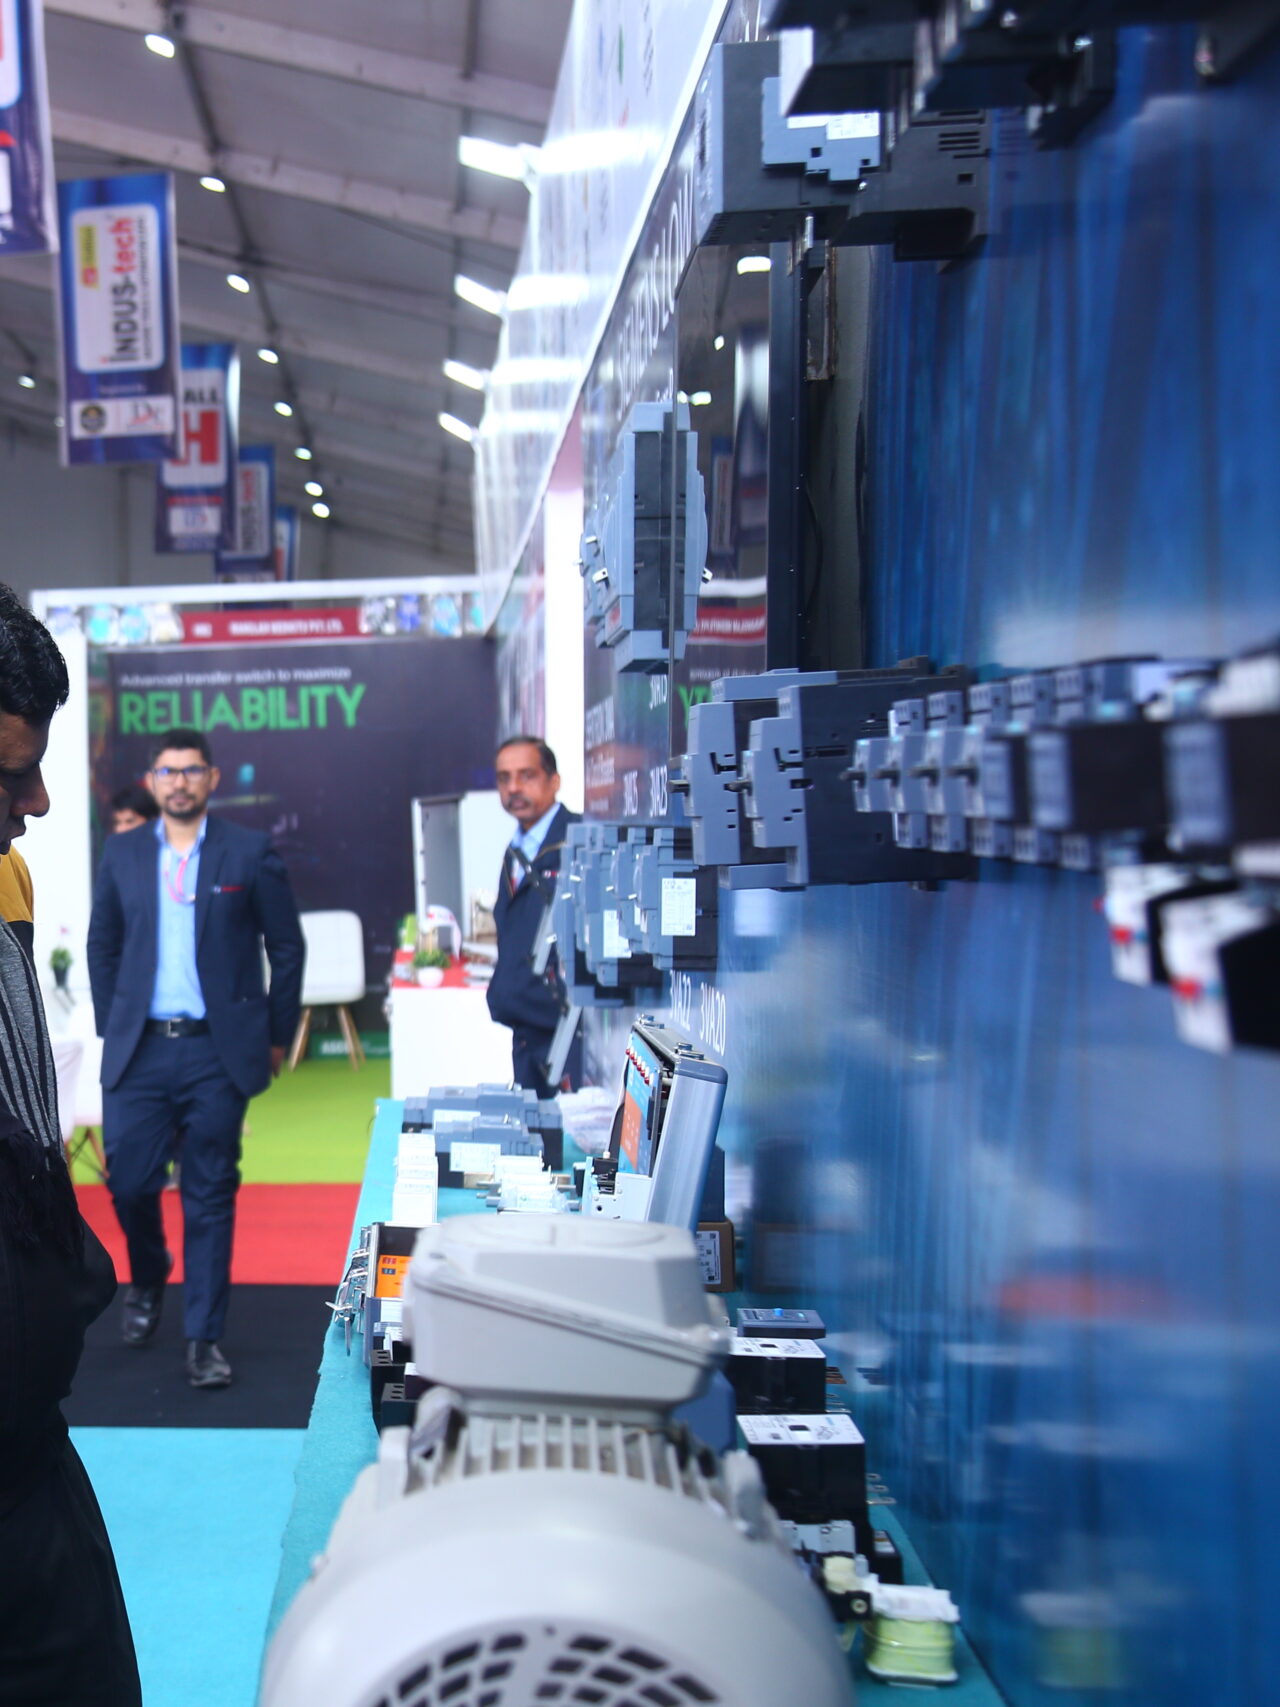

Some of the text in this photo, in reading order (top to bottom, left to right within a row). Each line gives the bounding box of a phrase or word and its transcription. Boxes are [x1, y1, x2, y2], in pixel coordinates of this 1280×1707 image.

[618, 243, 660, 418] SIEMENS
[662, 157, 694, 332] LOW
[121, 666, 352, 687] Advanced transfer switch to maximize
[120, 683, 367, 734] RELIABILITY
[699, 981, 726, 1057] 3VA20
